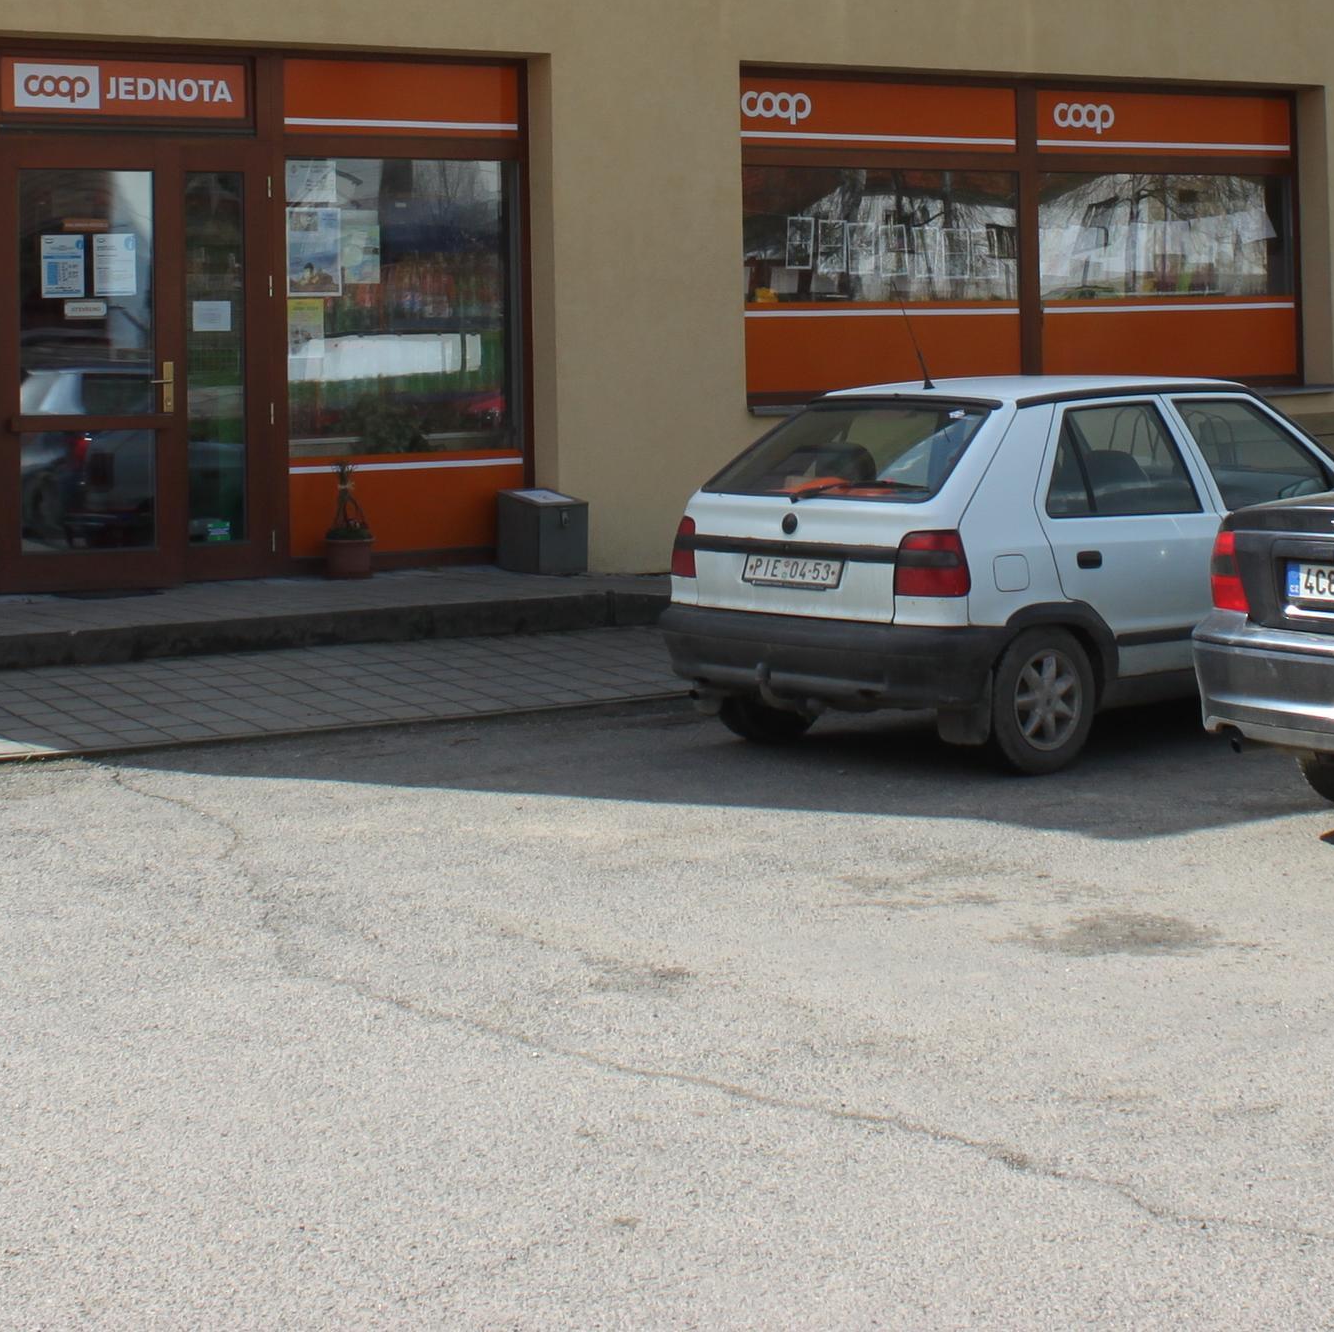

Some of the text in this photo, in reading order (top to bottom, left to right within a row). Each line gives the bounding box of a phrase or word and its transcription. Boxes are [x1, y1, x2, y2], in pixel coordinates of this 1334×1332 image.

[23, 74, 233, 103] coop JEDNOTA
[740, 91, 812, 125] coop
[1053, 102, 1115, 134] coop
